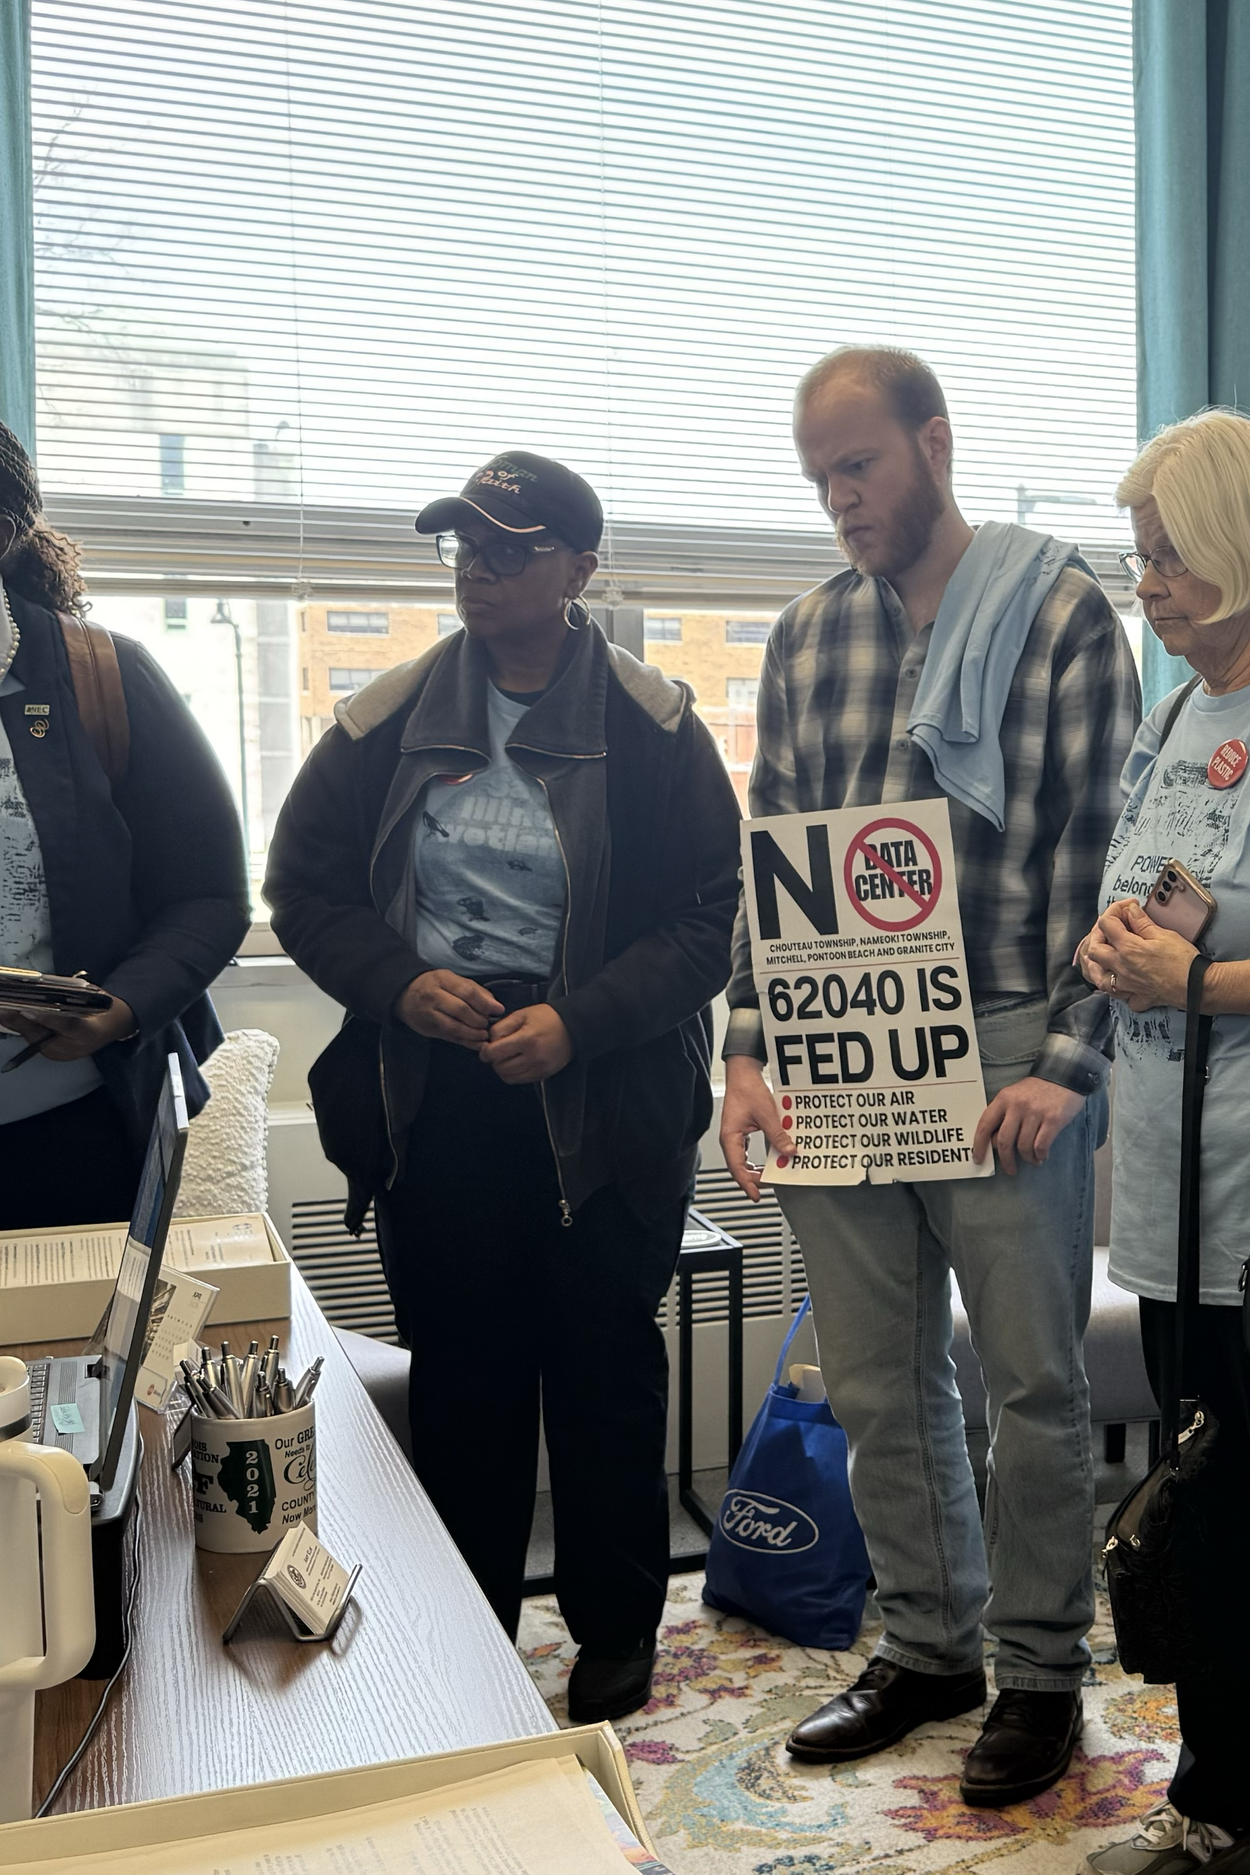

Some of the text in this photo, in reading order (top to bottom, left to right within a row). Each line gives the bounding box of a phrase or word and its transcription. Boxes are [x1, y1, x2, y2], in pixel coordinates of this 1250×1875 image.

[497, 470, 519, 481] of
[1211, 756, 1234, 781] PLASTIC
[864, 840, 918, 871] DATA
[854, 868, 933, 901] CENTER
[766, 942, 955, 965] MITCHELL, PONTOON BEACH AND GRANITE CITY
[769, 931, 950, 953] CHOUTEAU TOWNSHIP, NAMEOKI TOWNSHIP,
[768, 965, 962, 1022] 62040 IS
[774, 1024, 969, 1086] FED UP
[795, 1091, 915, 1110] PROTECT OUR AIR
[796, 1108, 948, 1129] PROTECT OUR WATER
[795, 1127, 964, 1150] PROTECT OUR WILDLIFE
[791, 1147, 974, 1169] PROTECT OUR RESIDENT
[274, 1437, 295, 1450] Our
[284, 1446, 305, 1459] Needs
[245, 1450, 260, 1514] 2021
[281, 1510, 302, 1525] Now
[723, 1496, 798, 1547] Ford
